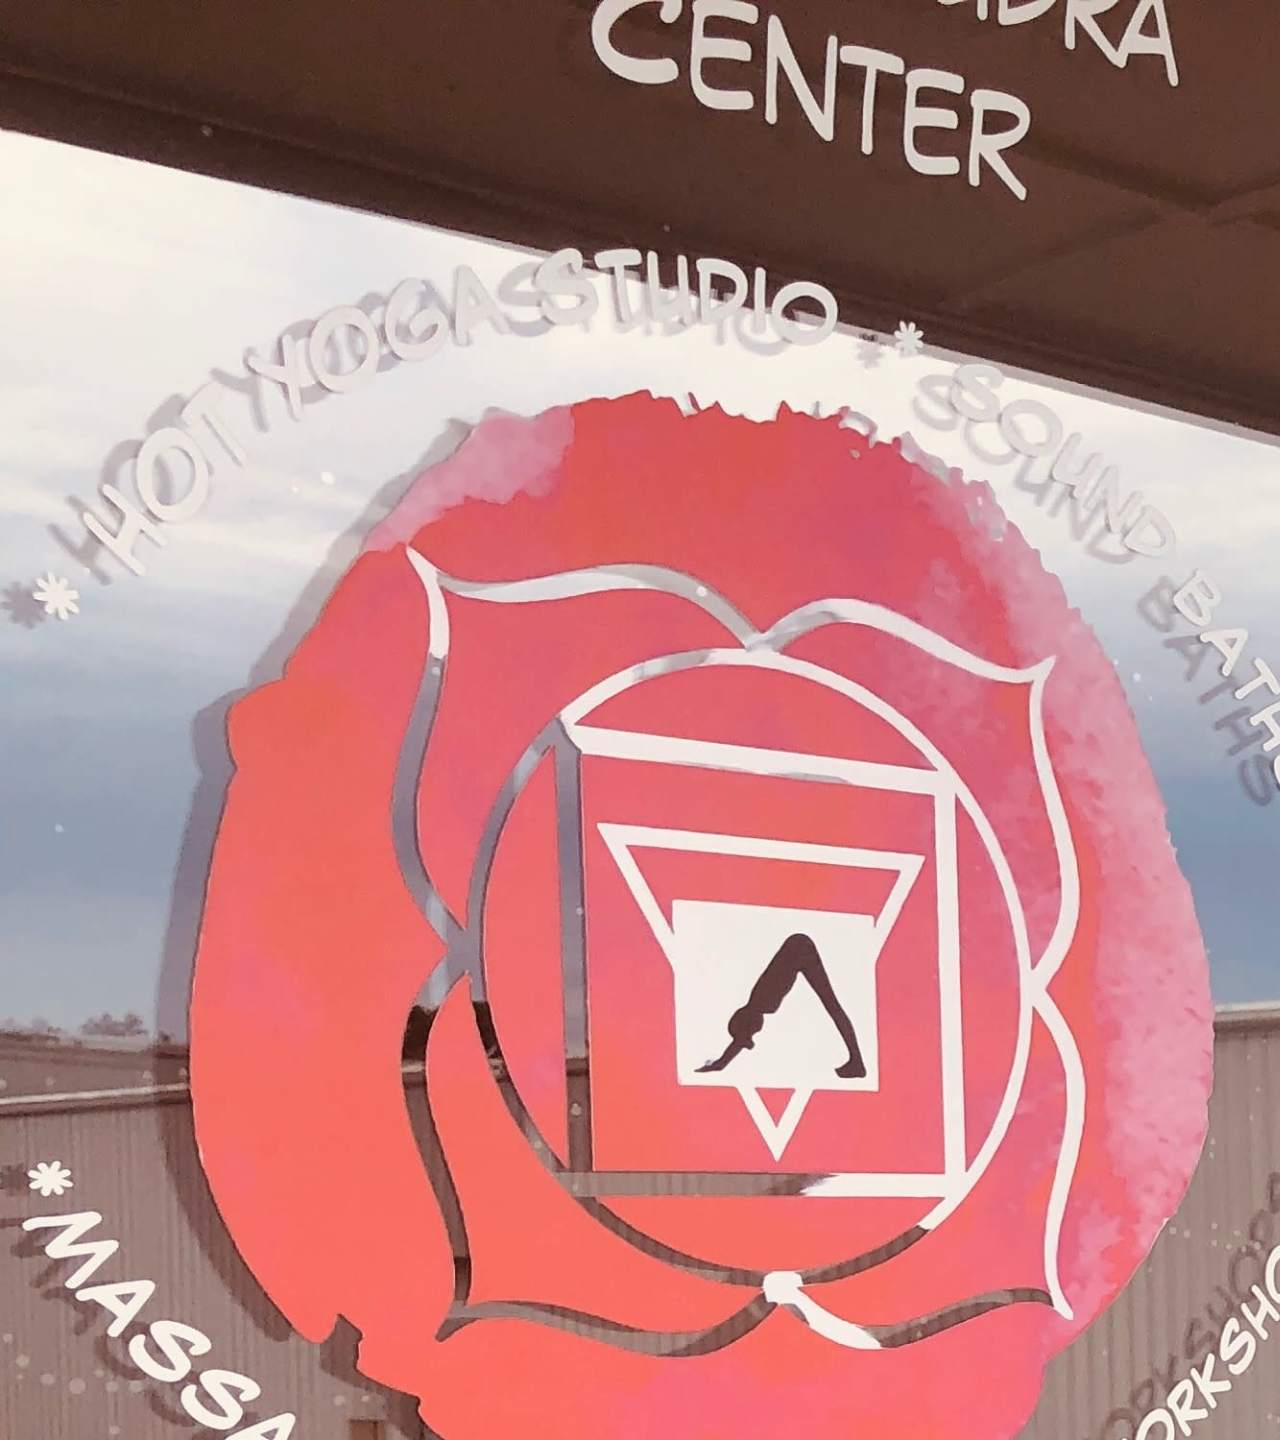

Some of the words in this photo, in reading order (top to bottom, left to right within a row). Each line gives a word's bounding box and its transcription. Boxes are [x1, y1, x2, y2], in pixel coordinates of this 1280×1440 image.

[592, 0, 1031, 200] CENTER
[82, 378, 249, 577] HOT
[246, 264, 508, 421] YOGA
[535, 247, 839, 346] STUDIO
[950, 363, 1176, 558] SOUND
